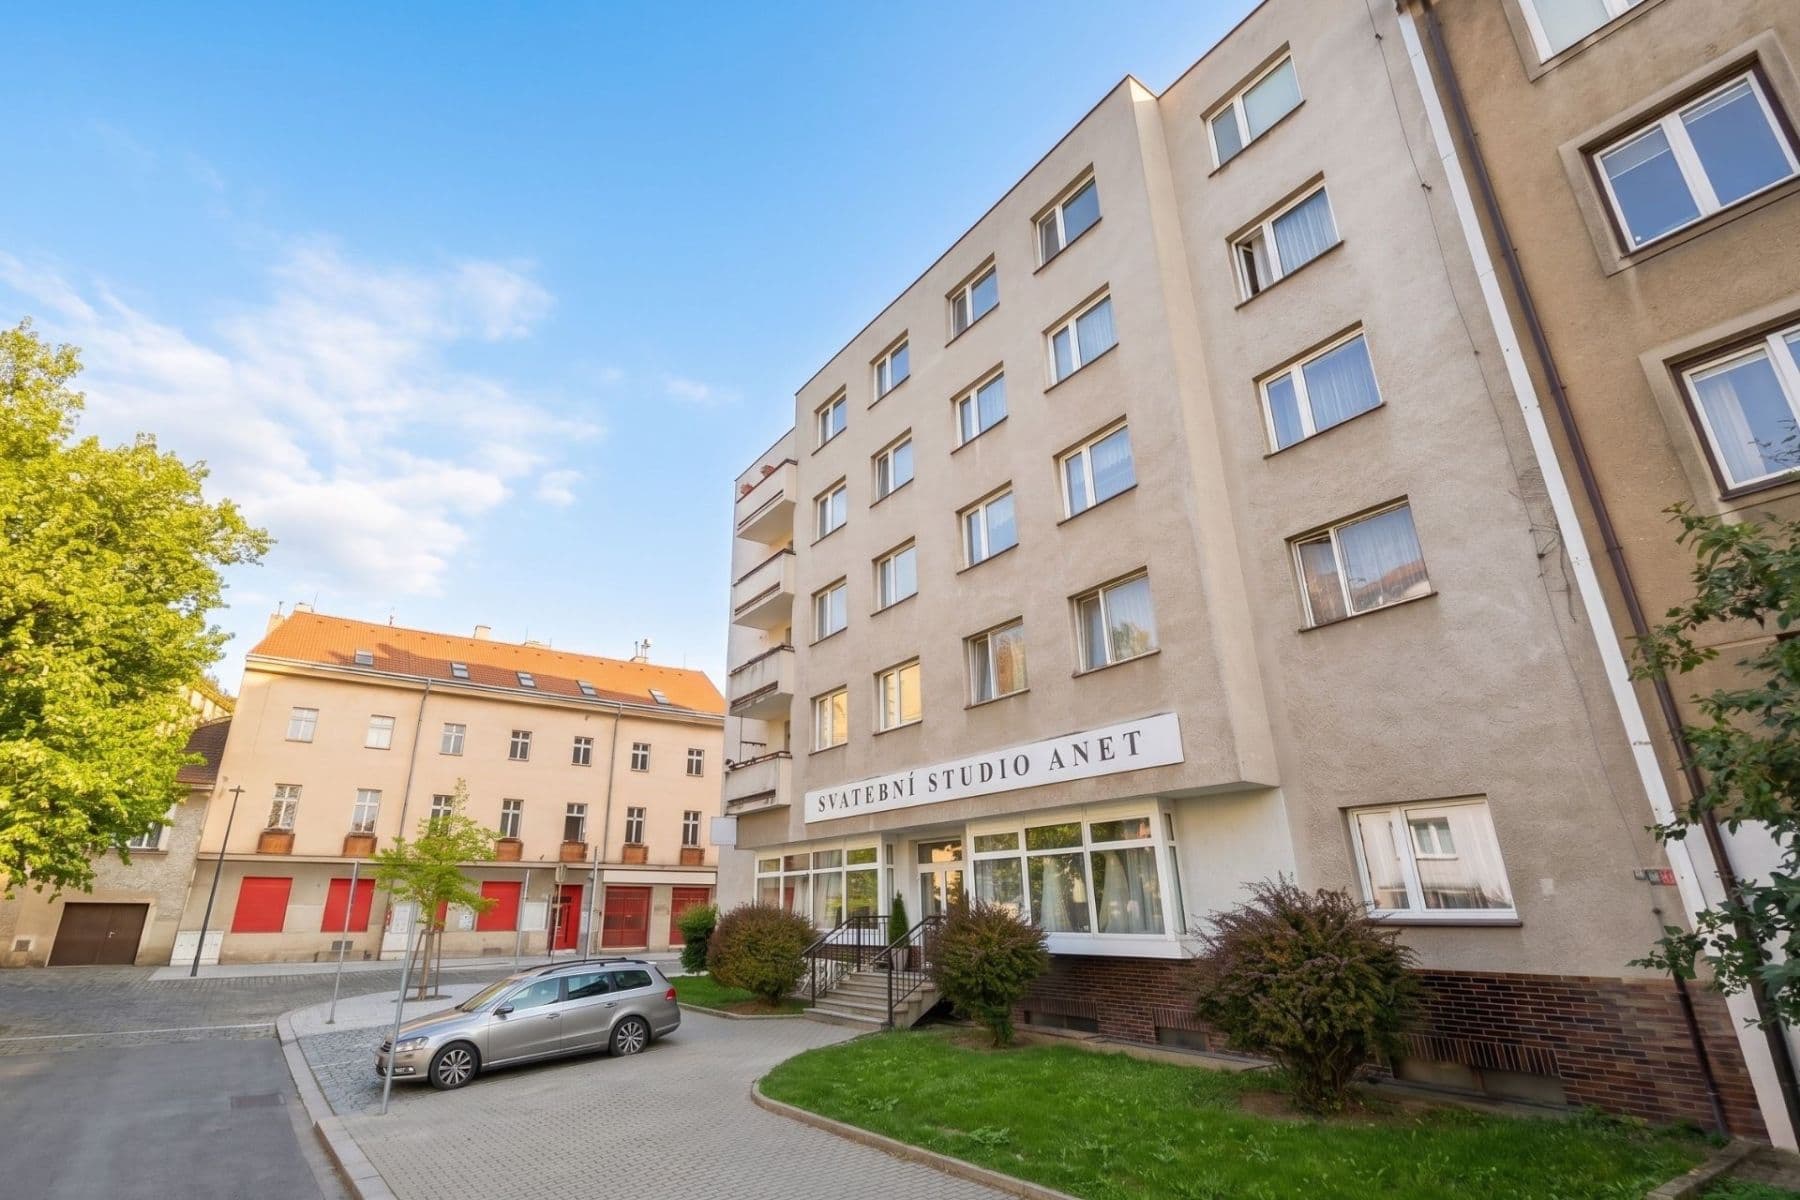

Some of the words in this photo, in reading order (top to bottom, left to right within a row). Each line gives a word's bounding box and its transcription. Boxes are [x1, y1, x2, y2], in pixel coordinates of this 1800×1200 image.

[819, 772, 915, 812] SVATEBNÍ
[928, 754, 1030, 792] STUDIO
[1049, 730, 1142, 770] ANET
